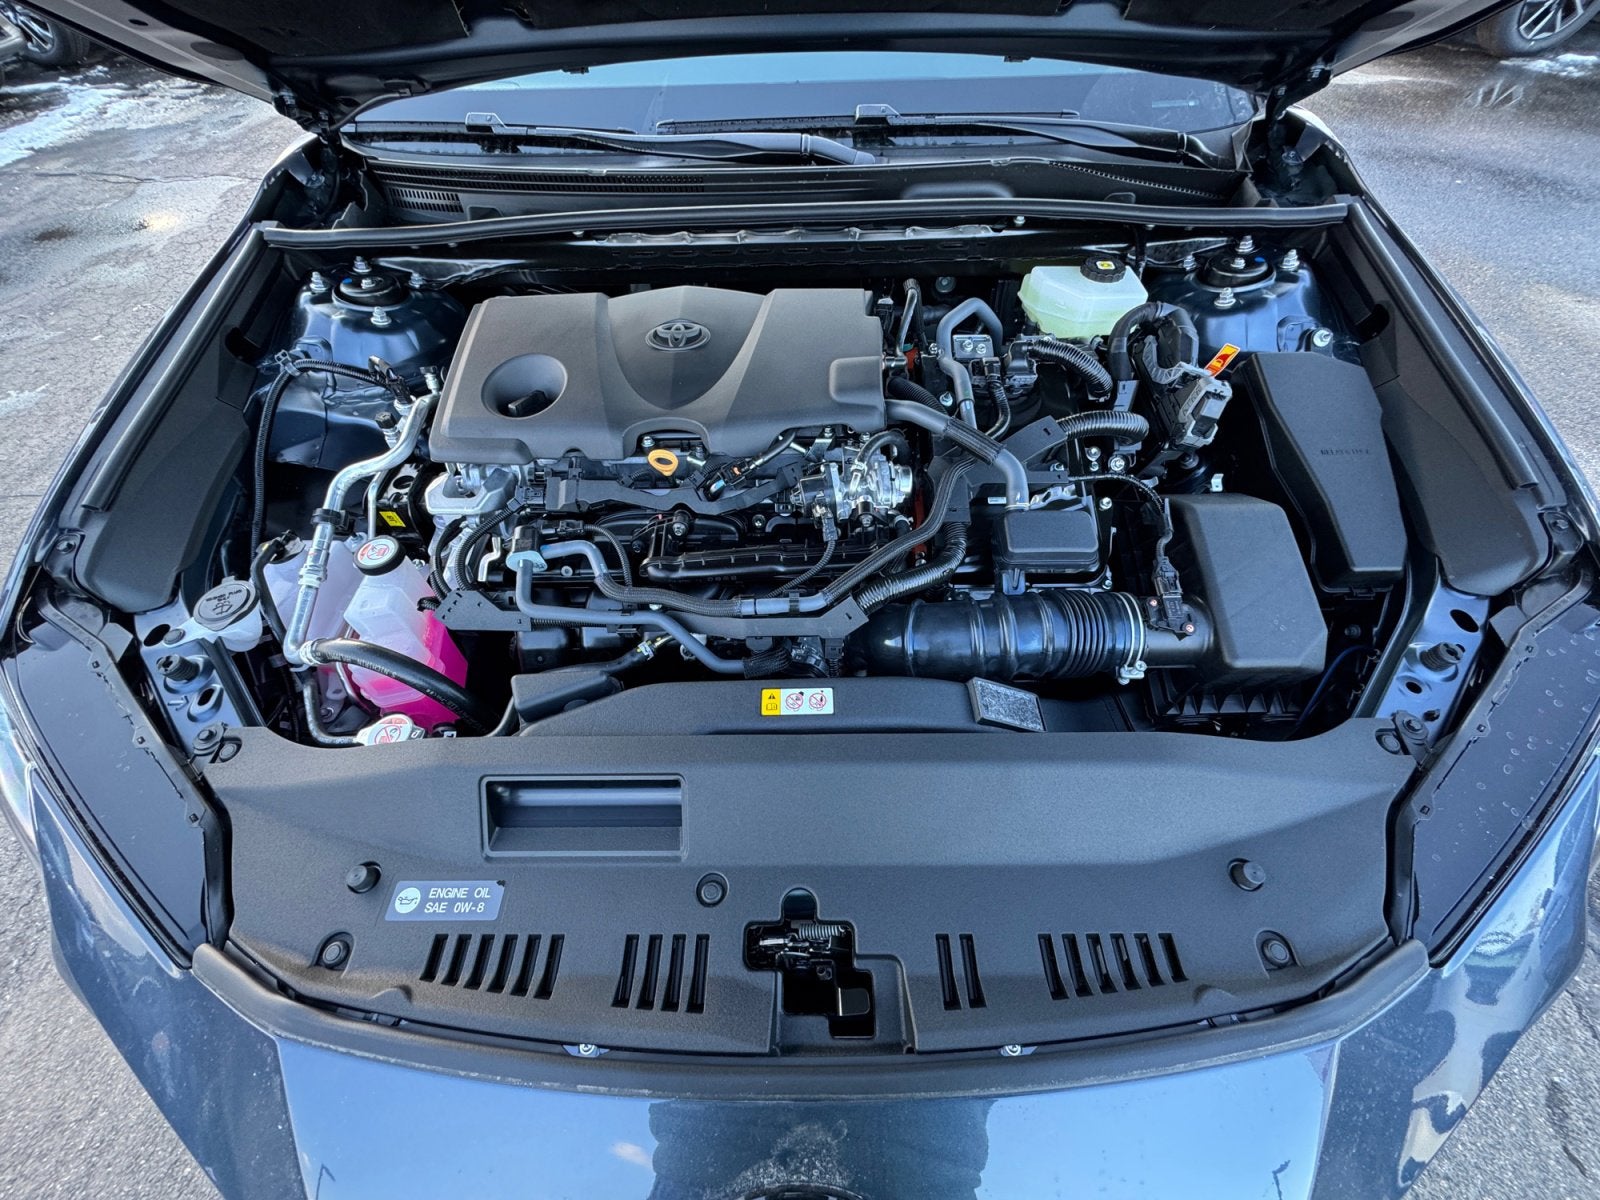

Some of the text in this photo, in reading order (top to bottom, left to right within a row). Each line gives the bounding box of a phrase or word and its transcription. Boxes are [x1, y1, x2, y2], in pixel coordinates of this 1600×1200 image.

[428, 887, 491, 898] ENGINE OIL
[424, 902, 485, 913] SAE 0W-8
